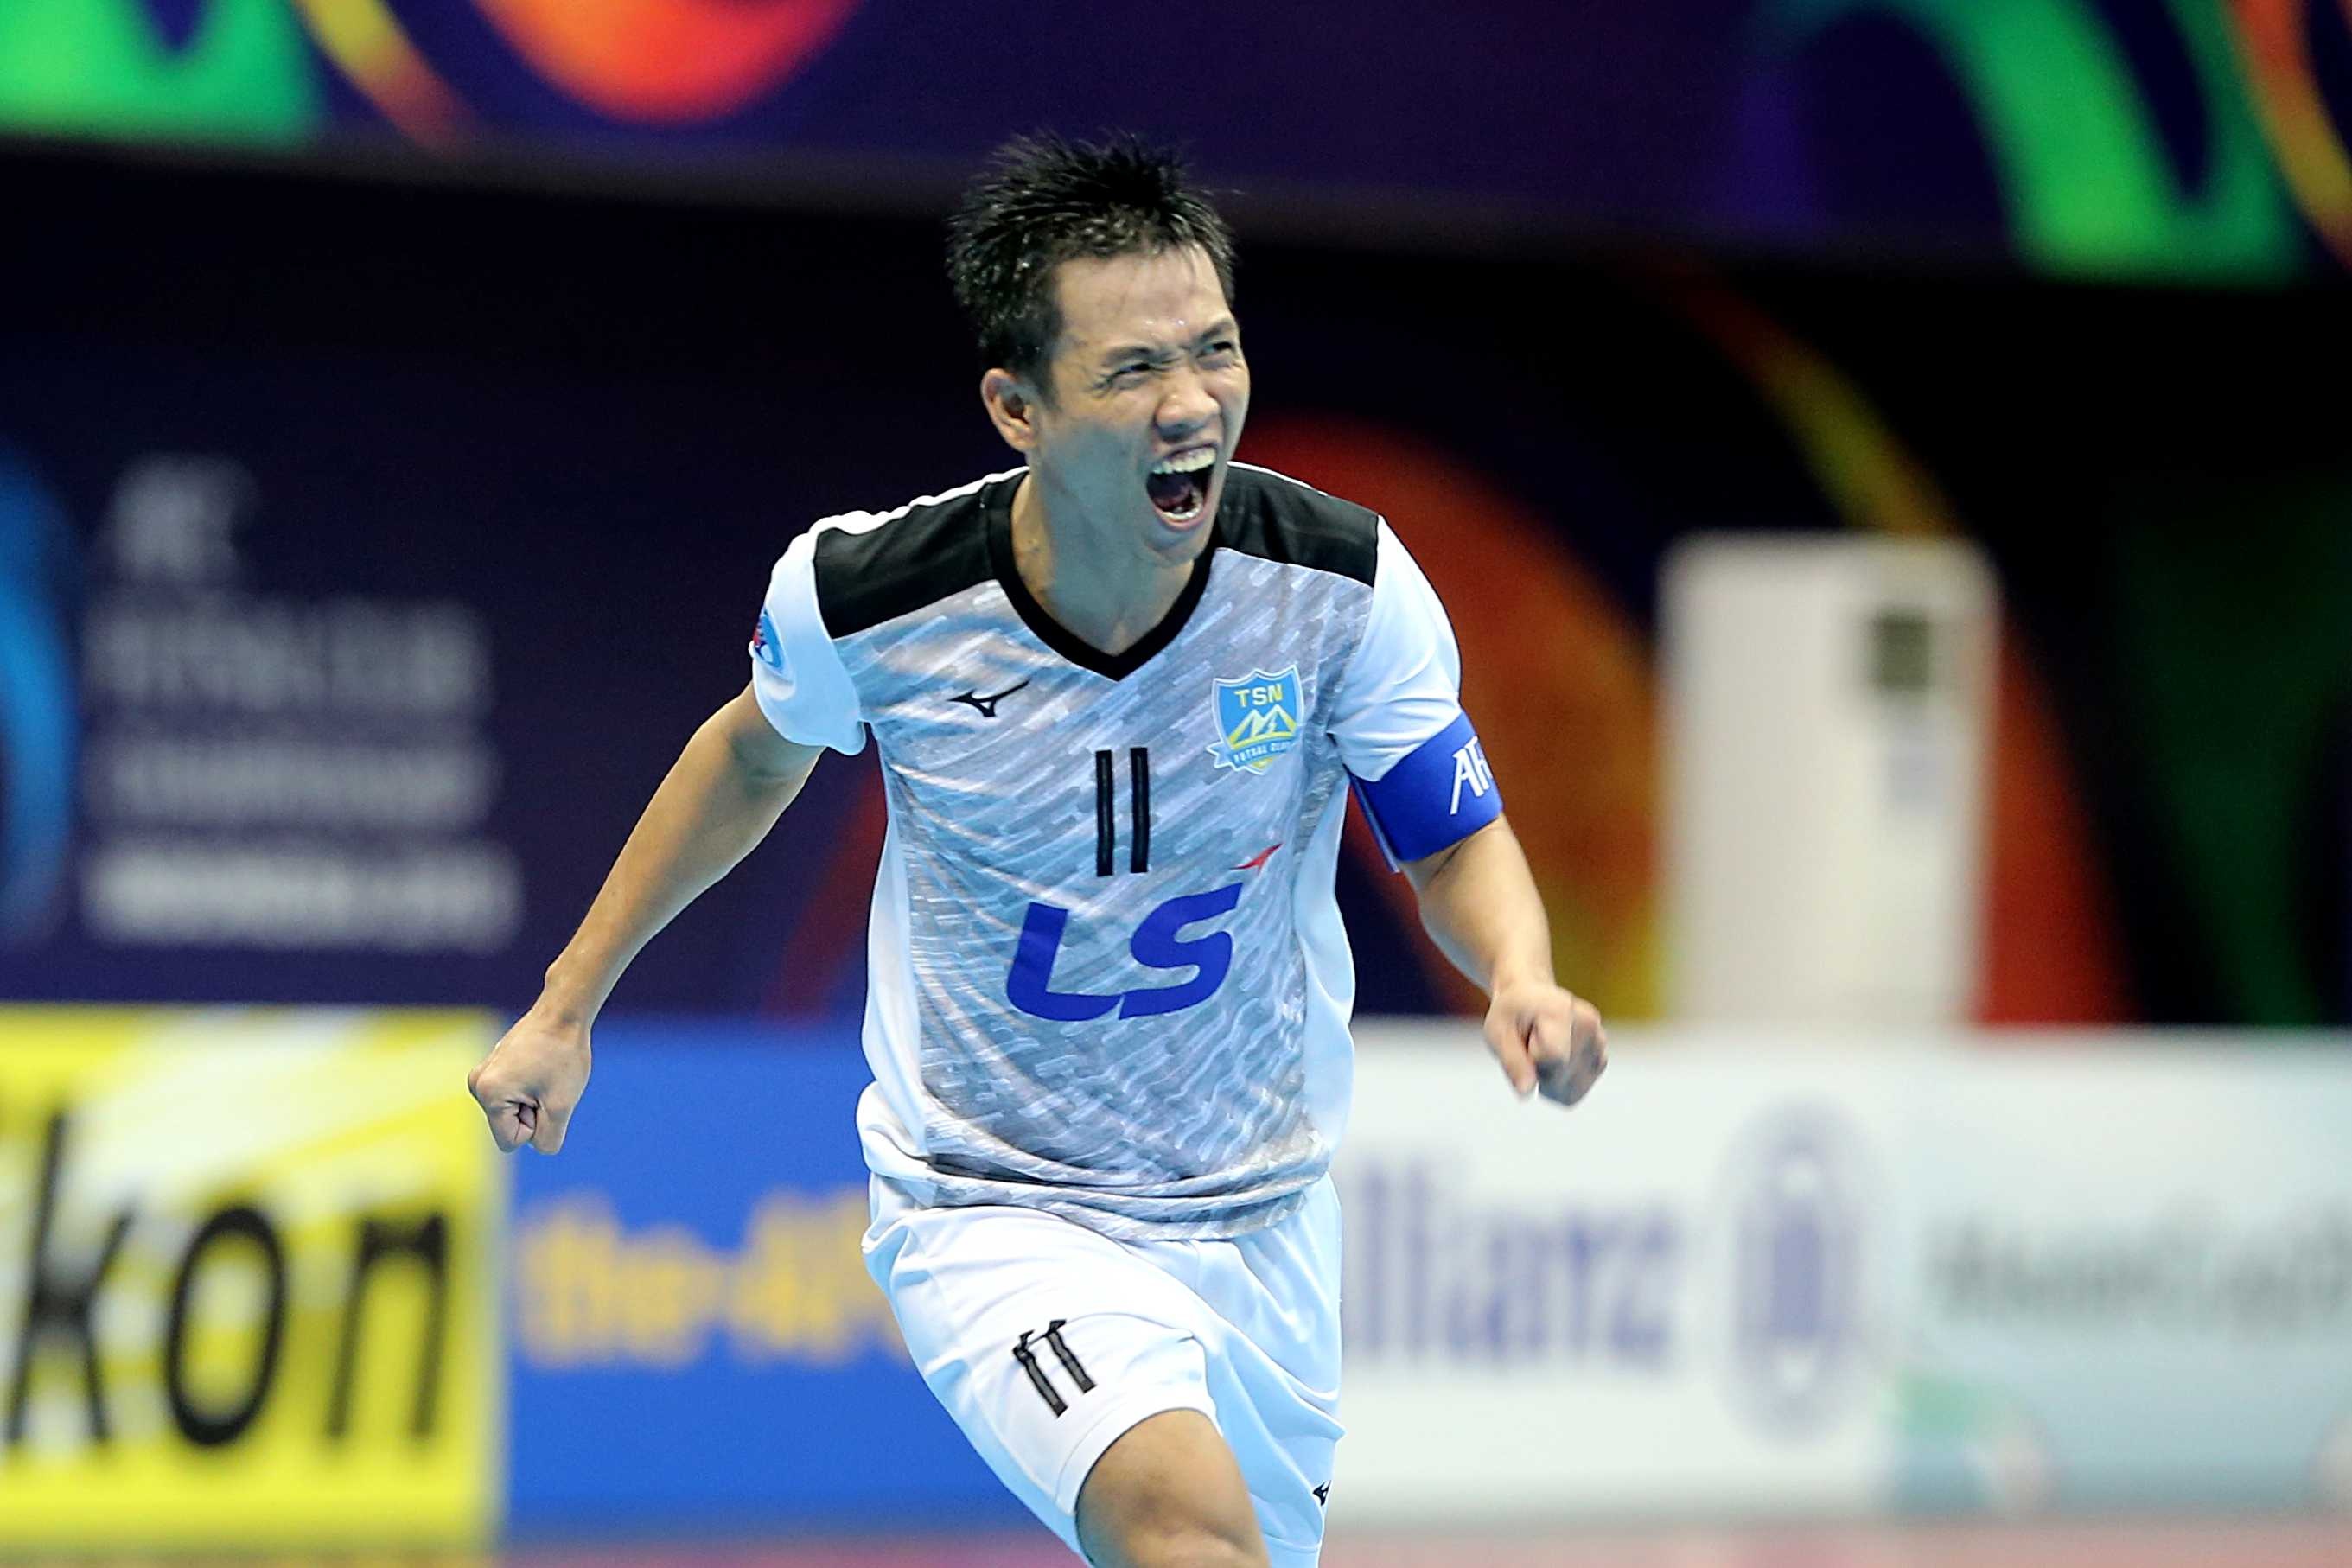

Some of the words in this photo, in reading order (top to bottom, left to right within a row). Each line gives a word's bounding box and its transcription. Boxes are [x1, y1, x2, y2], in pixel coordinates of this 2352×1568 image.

[1233, 683, 1284, 708] TSN
[1095, 747, 1150, 877] 11
[1006, 882, 1244, 1022] LS
[1011, 1318, 1098, 1418] 11
